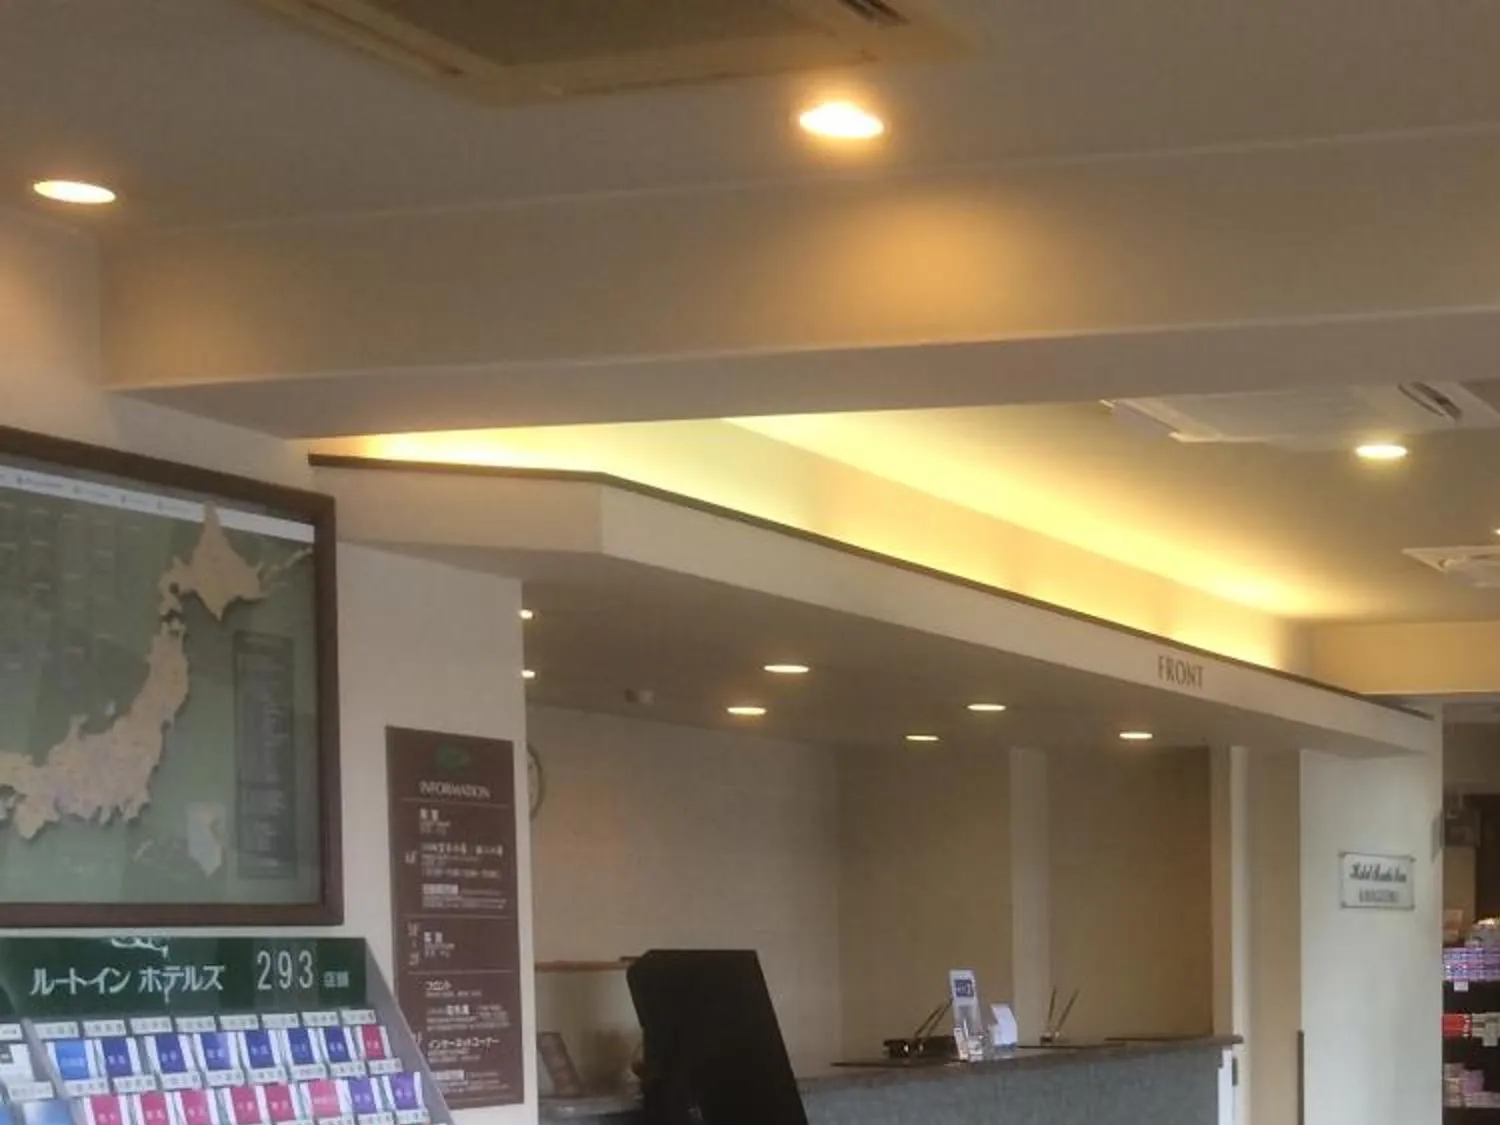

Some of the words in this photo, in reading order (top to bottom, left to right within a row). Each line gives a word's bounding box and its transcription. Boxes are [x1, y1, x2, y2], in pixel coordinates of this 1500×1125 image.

[1158, 655, 1204, 690] FRONT
[419, 780, 492, 799] INFORMATION
[30, 967, 131, 996] ルートイン
[138, 965, 226, 1003] ホテルズ
[257, 950, 315, 991] 293
